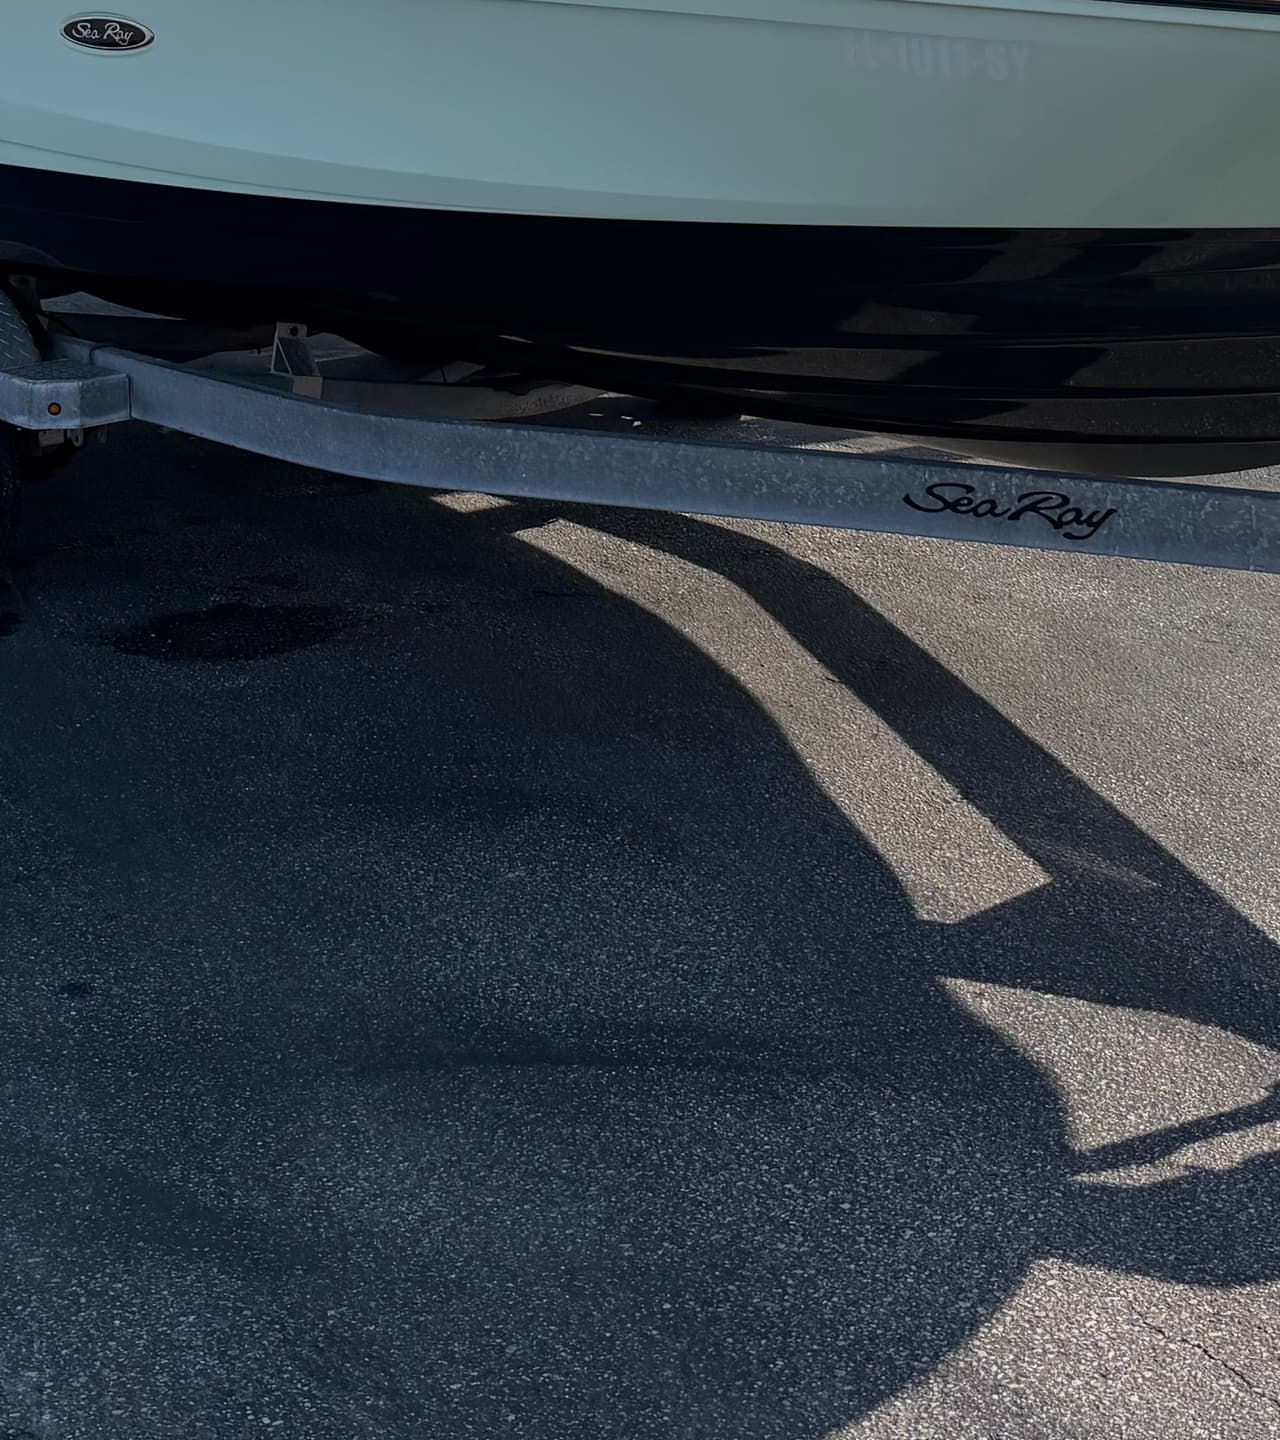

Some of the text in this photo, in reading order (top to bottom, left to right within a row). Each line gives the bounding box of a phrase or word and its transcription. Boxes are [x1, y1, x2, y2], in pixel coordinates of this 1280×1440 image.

[72, 22, 134, 46] Sea Ray
[903, 482, 1118, 540] Sea Ray
